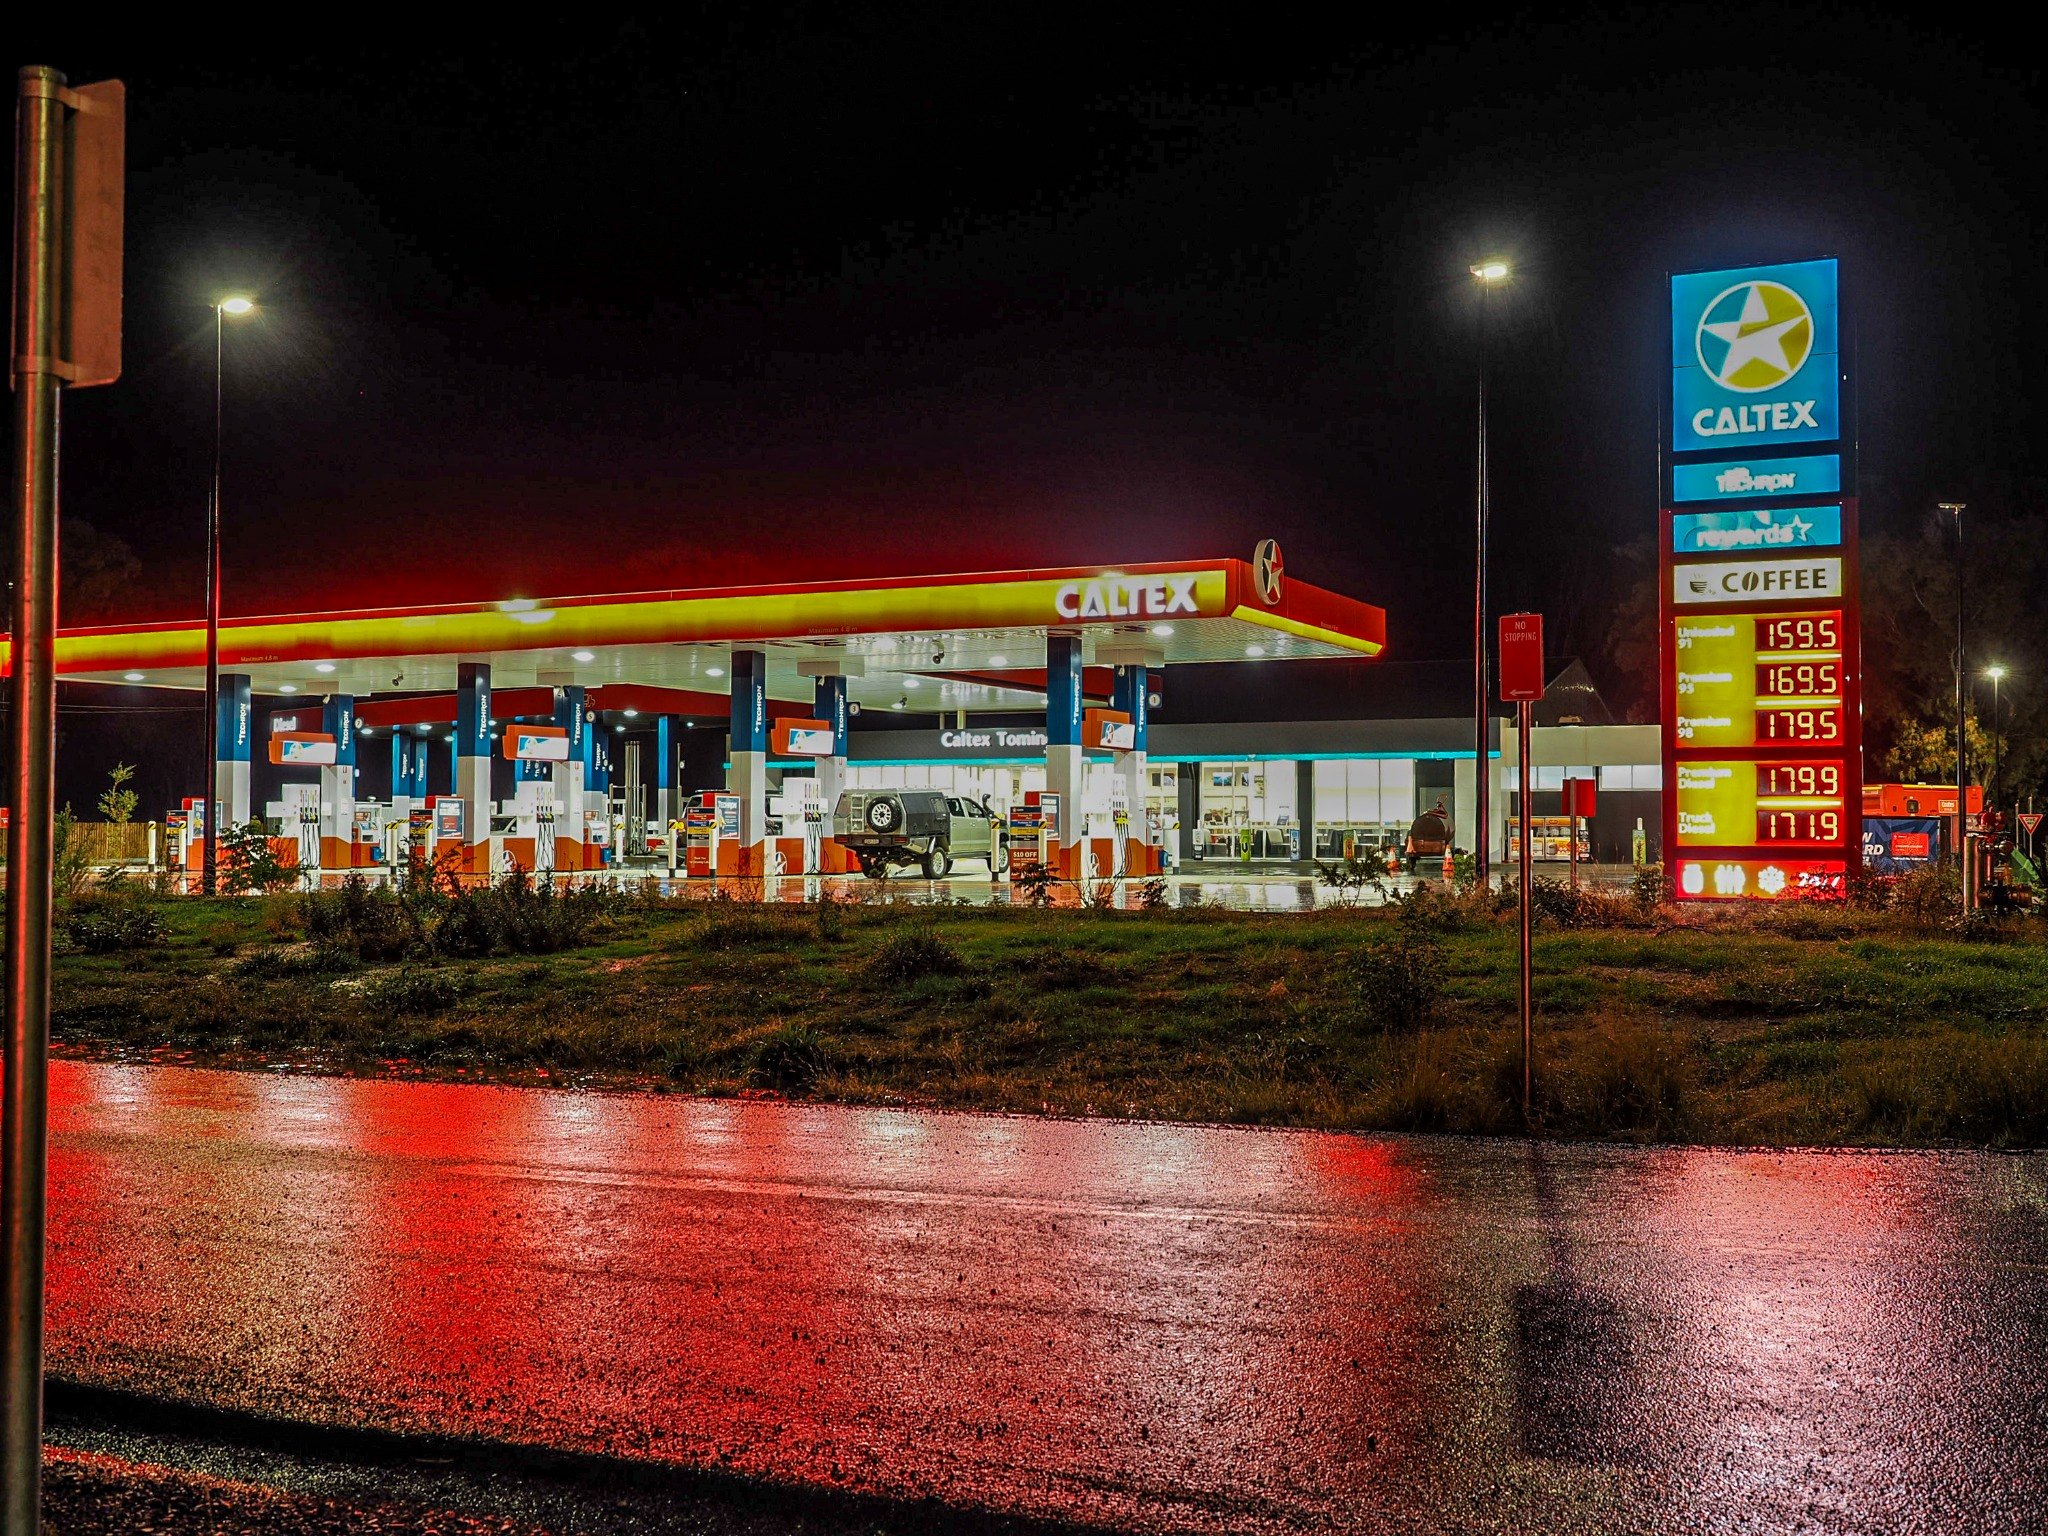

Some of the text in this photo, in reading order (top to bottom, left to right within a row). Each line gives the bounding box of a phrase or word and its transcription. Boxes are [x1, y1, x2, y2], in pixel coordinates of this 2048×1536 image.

[1693, 400, 1818, 437] CALTEX
[1697, 523, 1794, 547] rewards
[1722, 568, 1827, 593] COFFEE
[1054, 577, 1198, 619] CALTEX
[1504, 631, 1537, 641] STOPPING
[1515, 621, 1526, 630] NO
[1769, 619, 1837, 649] 159.5
[1678, 638, 1692, 649] 91
[1678, 683, 1695, 695] 95
[1769, 665, 1837, 694] 169.5
[1678, 728, 1694, 738] 98
[1769, 711, 1837, 740] 179.5
[941, 731, 991, 748] Caltex
[1770, 766, 1838, 795] 179.9
[1770, 812, 1838, 840] 171.9
